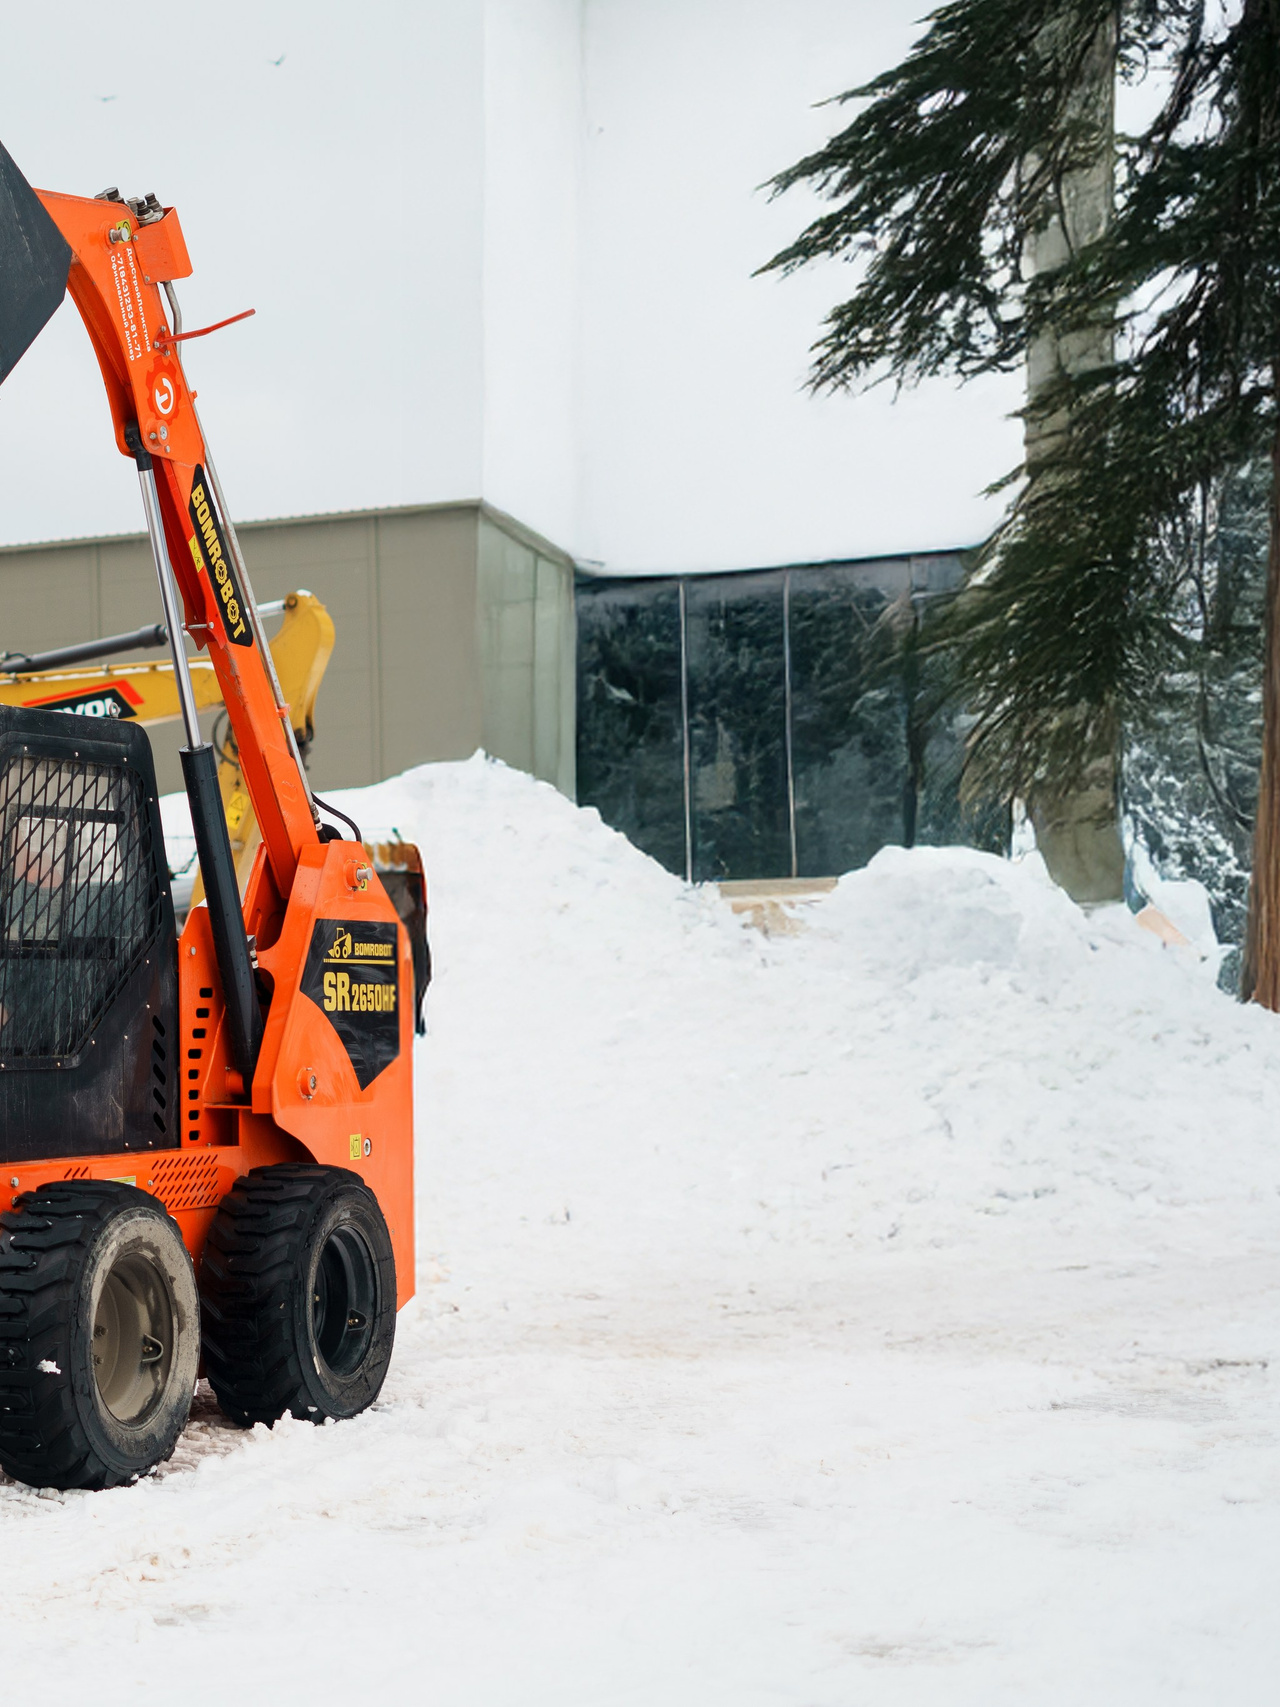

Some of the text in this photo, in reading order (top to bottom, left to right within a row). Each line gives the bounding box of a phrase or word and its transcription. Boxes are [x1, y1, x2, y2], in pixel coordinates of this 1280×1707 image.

[110, 255, 136, 361] Официальный дилер
[117, 252, 142, 359] +7(843)253-81-71
[126, 247, 151, 352] ДорСтройЛогистика
[191, 483, 246, 639] BOMROBOT
[354, 942, 394, 957] BOMROBOT
